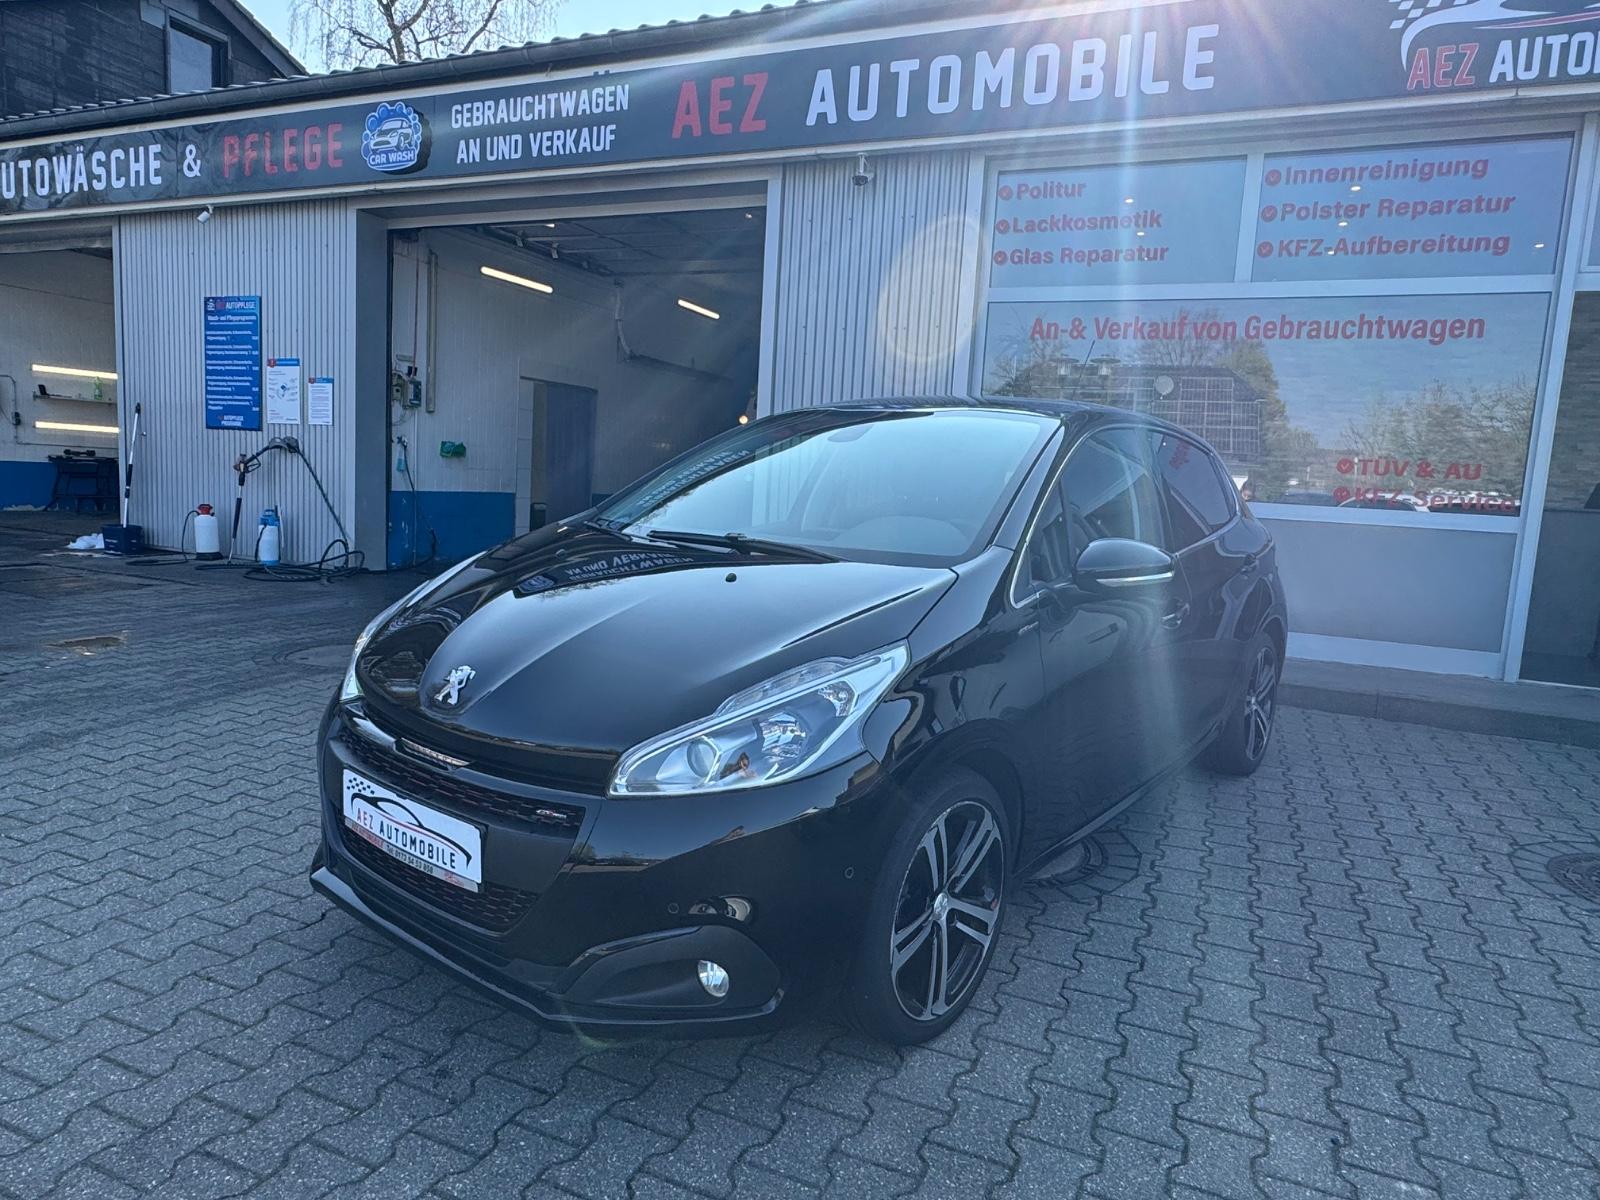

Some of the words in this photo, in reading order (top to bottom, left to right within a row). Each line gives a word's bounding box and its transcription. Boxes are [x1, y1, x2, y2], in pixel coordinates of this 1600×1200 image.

[1406, 42, 1479, 91] AEZ
[1488, 31, 1600, 83] AUTO
[672, 72, 768, 139] AEZ
[805, 23, 1220, 127] AUTOMOBILE
[451, 83, 630, 130] GEBRAUCHTWAGEN
[369, 153, 387, 165] CAR
[388, 150, 414, 163] WASH
[456, 138, 480, 165] AN
[486, 133, 522, 161] UND
[530, 124, 617, 158] VERKAUF
[1, 144, 162, 199] UTOWÄSCHE
[183, 144, 201, 178] &
[223, 123, 344, 178] PFLEGE
[1285, 158, 1489, 186] Innenreinigung
[1016, 181, 1087, 200] Politur
[1012, 209, 1162, 234] Lackkosmetik
[1280, 201, 1370, 222] Polster
[1377, 194, 1516, 220] Reparatur
[1009, 247, 1054, 265] Glas
[1060, 245, 1169, 267] Reparatur
[1277, 234, 1511, 258] KFZ-Aufbereitung
[1093, 315, 1189, 341] Verkauf
[1192, 321, 1237, 341] von
[1244, 314, 1486, 346] Gebrauchtwagen
[1358, 456, 1410, 477] TÜV
[1415, 458, 1435, 479] &
[1443, 462, 1484, 481] AU
[356, 807, 374, 830] AEZ
[379, 821, 456, 869] AUTOMOBILE
